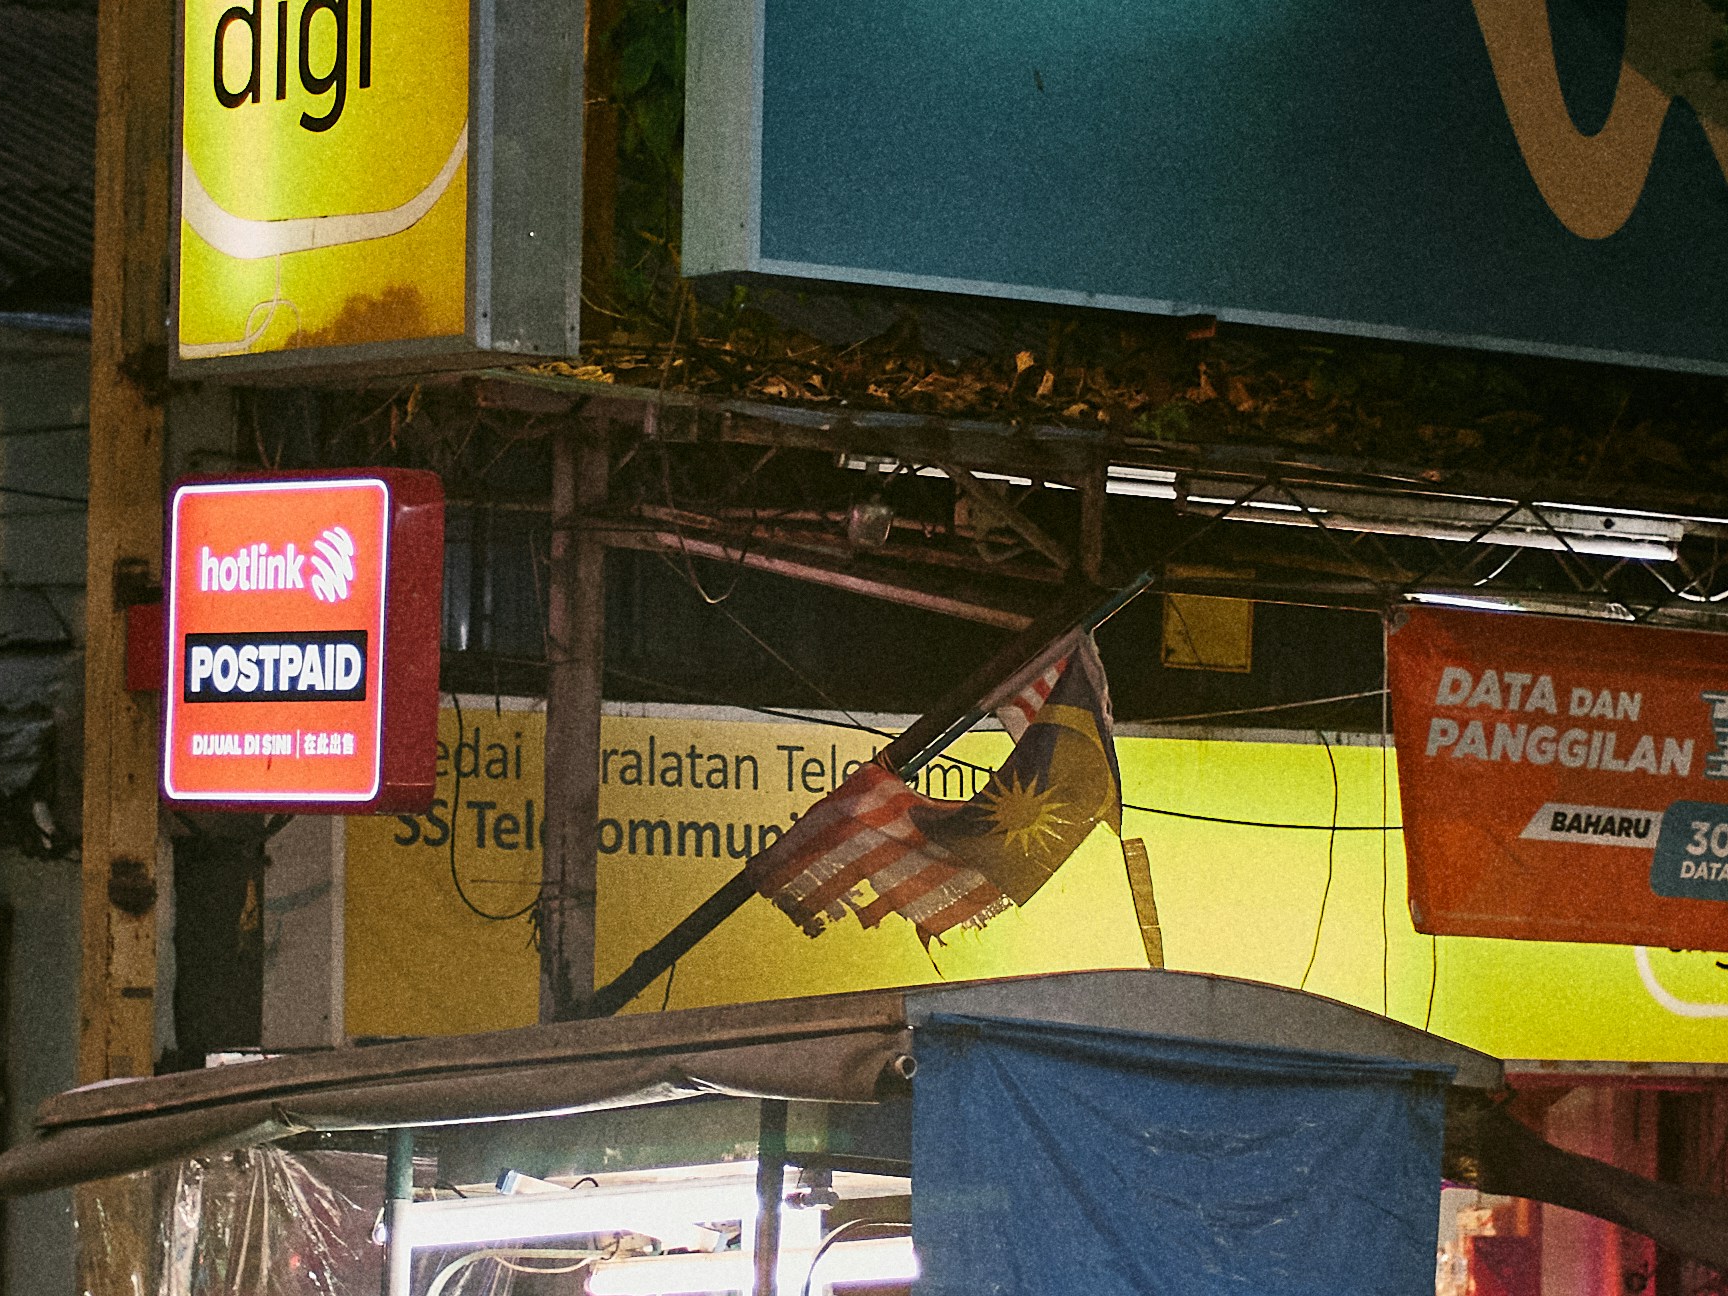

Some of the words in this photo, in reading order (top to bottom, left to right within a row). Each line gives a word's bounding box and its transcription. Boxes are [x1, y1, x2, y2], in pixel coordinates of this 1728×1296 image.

[200, 543, 304, 591] hotlink
[190, 644, 362, 693] POSTPAID
[1435, 666, 1558, 715] DATA
[1568, 687, 1642, 722] DAN
[192, 734, 242, 755] DIJUAL
[244, 734, 260, 755] DI
[262, 734, 292, 755] SINI
[304, 732, 355, 756] 在此出售
[435, 727, 523, 780] edai
[601, 735, 759, 791] ralatan
[1425, 718, 1696, 777] PANGGILAN
[1550, 811, 1652, 839] BAHARU
